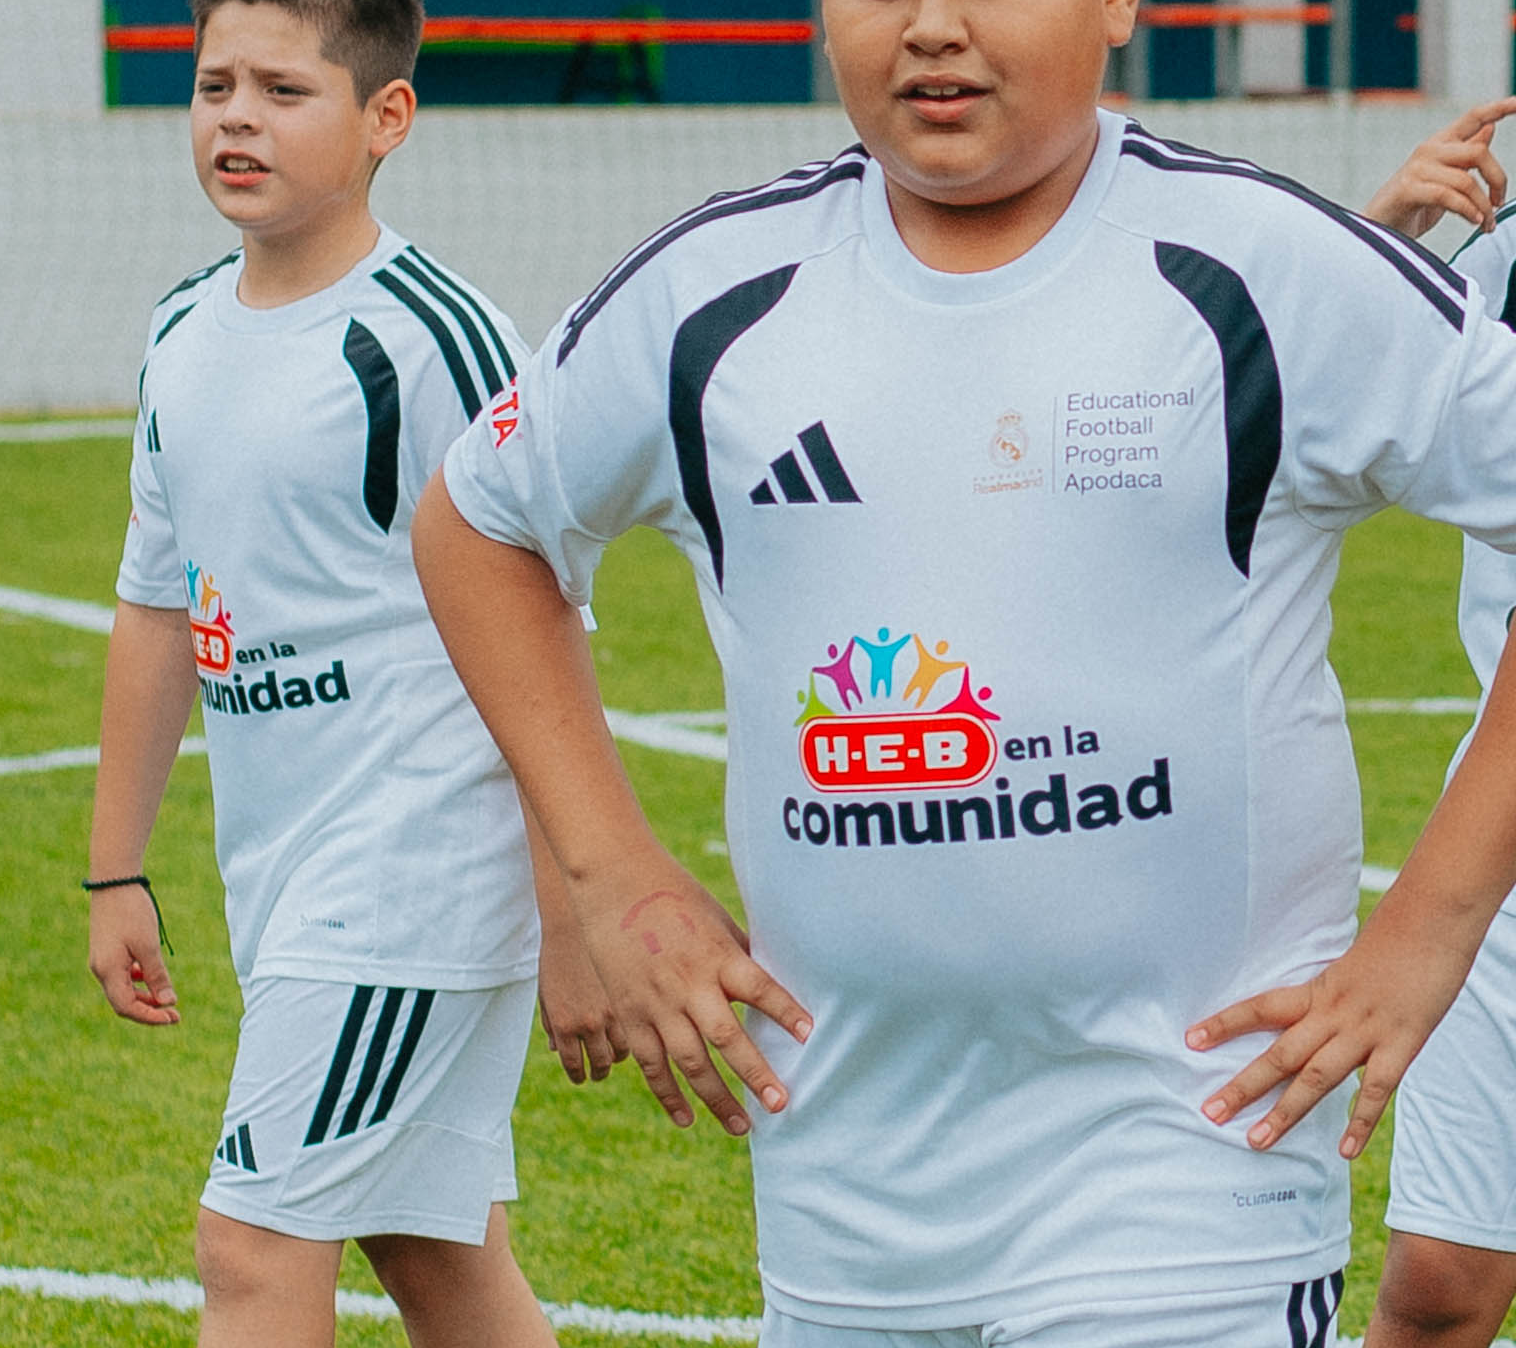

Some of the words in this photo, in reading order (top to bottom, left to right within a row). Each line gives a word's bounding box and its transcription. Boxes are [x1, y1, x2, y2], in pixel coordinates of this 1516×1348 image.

[1066, 387, 1195, 412] Educational
[1065, 416, 1153, 438] Football
[1064, 445, 1159, 467] Program
[1064, 470, 1163, 496] Apodaca
[235, 647, 266, 665] en
[269, 641, 297, 659] la
[198, 659, 351, 715] munidad
[1003, 734, 1052, 761] en
[1063, 725, 1100, 756] la
[783, 757, 1173, 847] comunidad
